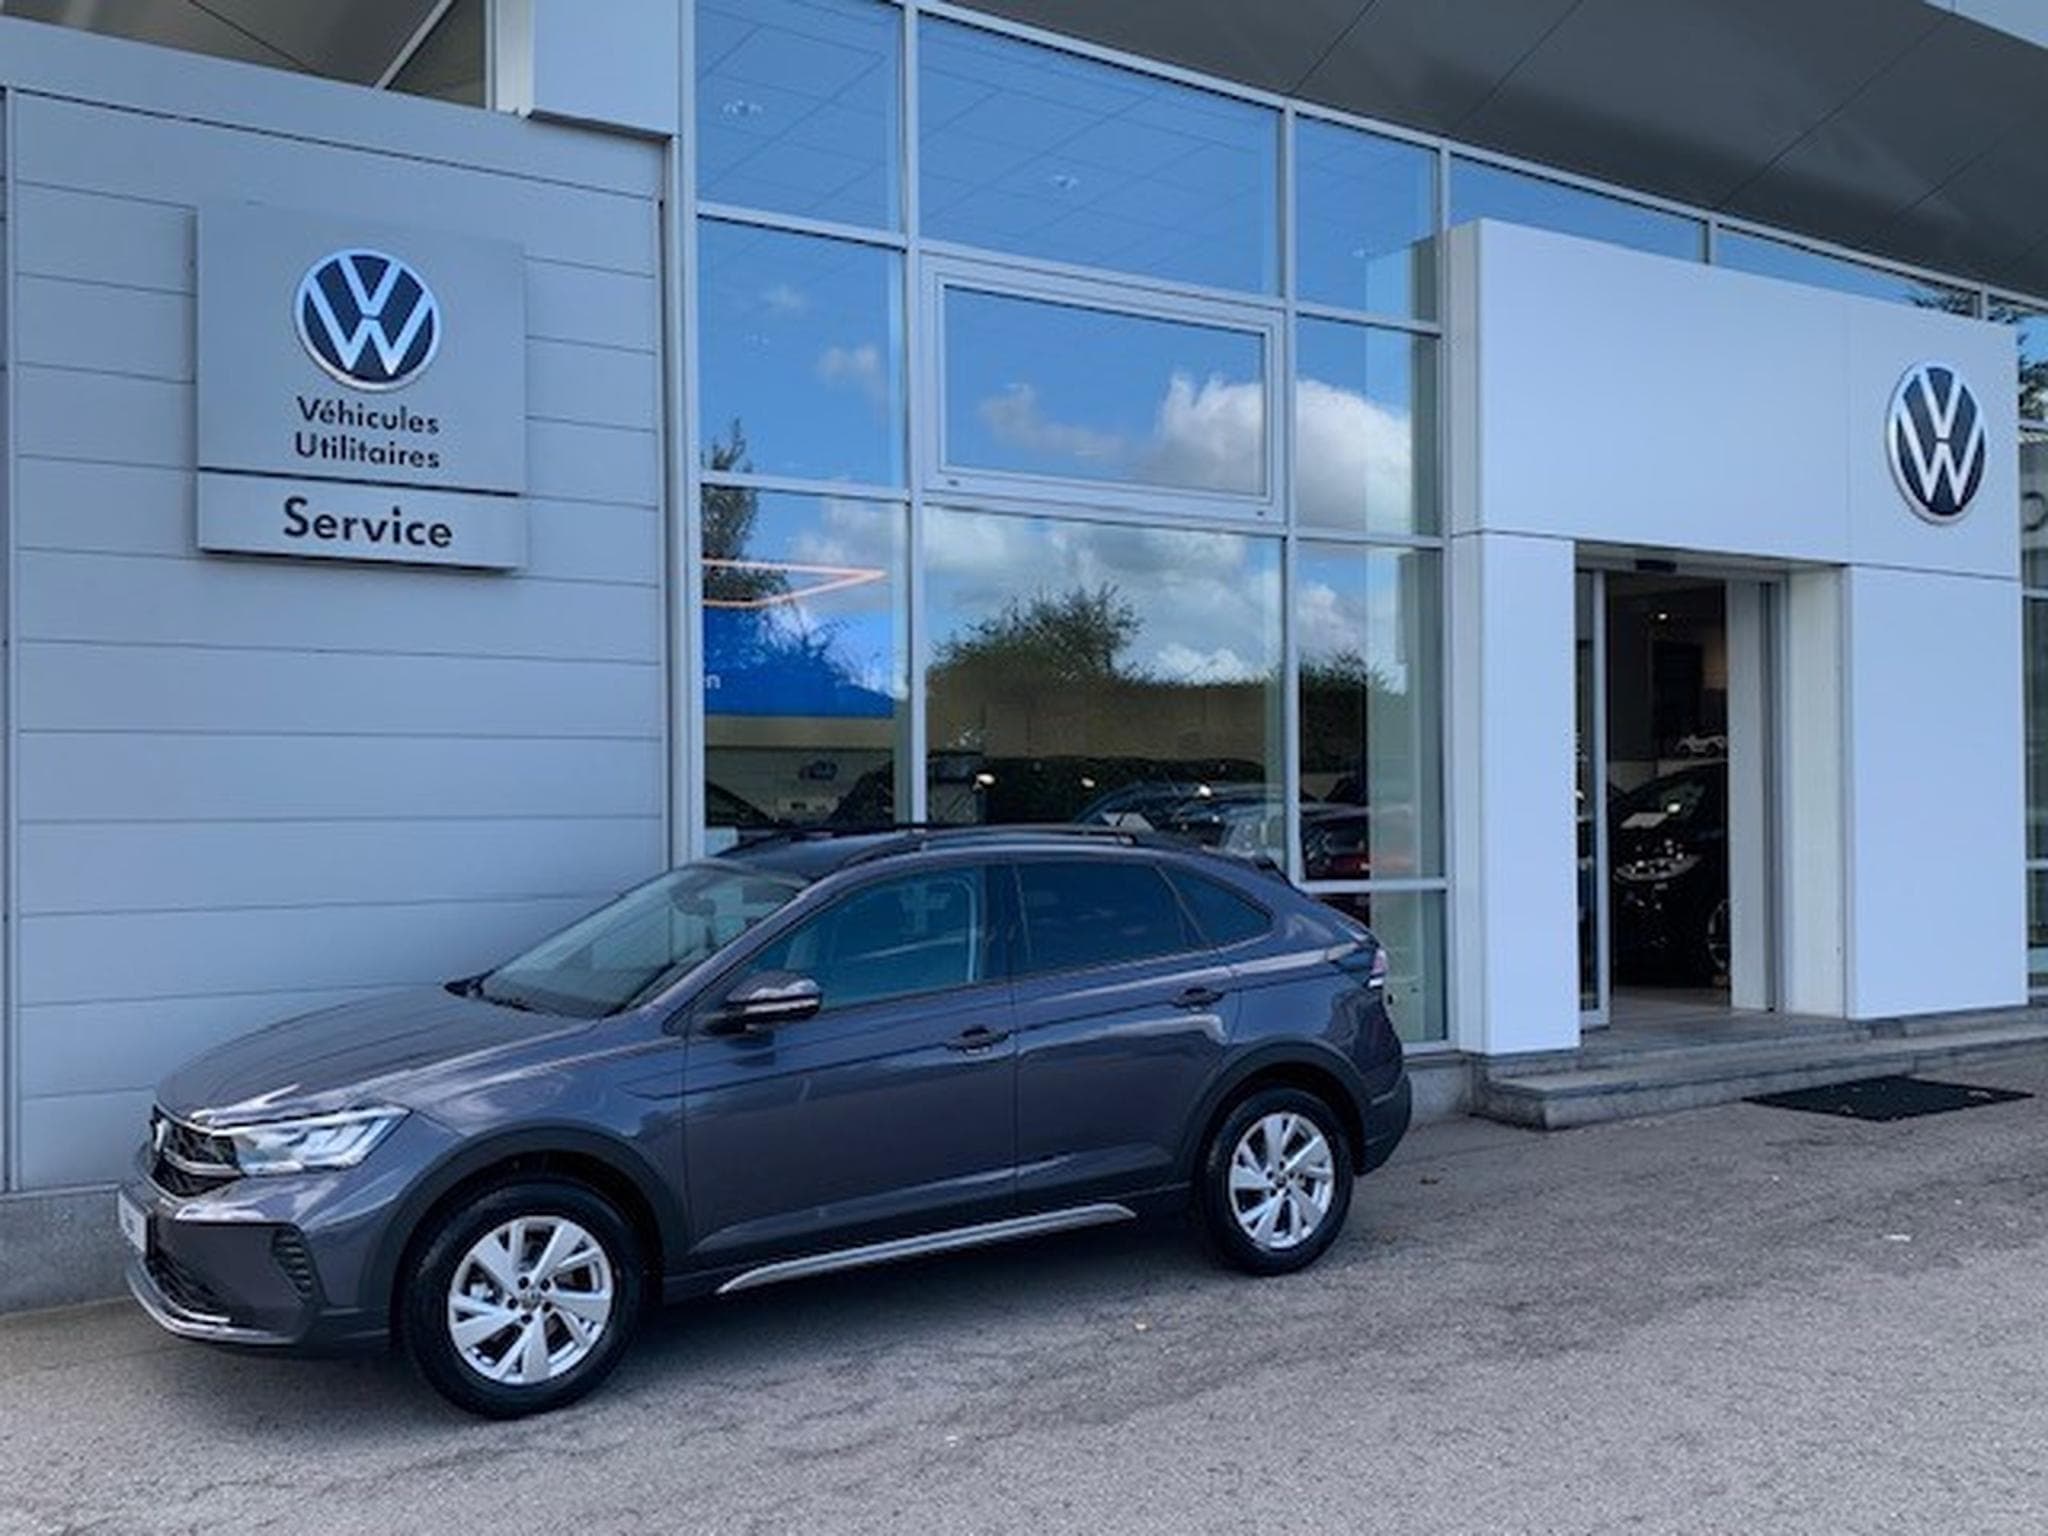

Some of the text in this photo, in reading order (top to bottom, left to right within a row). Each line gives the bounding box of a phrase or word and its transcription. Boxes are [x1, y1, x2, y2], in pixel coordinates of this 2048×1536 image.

[297, 395, 440, 434] Véhicules
[295, 431, 441, 469] Utilitaires
[283, 496, 453, 549] Service
